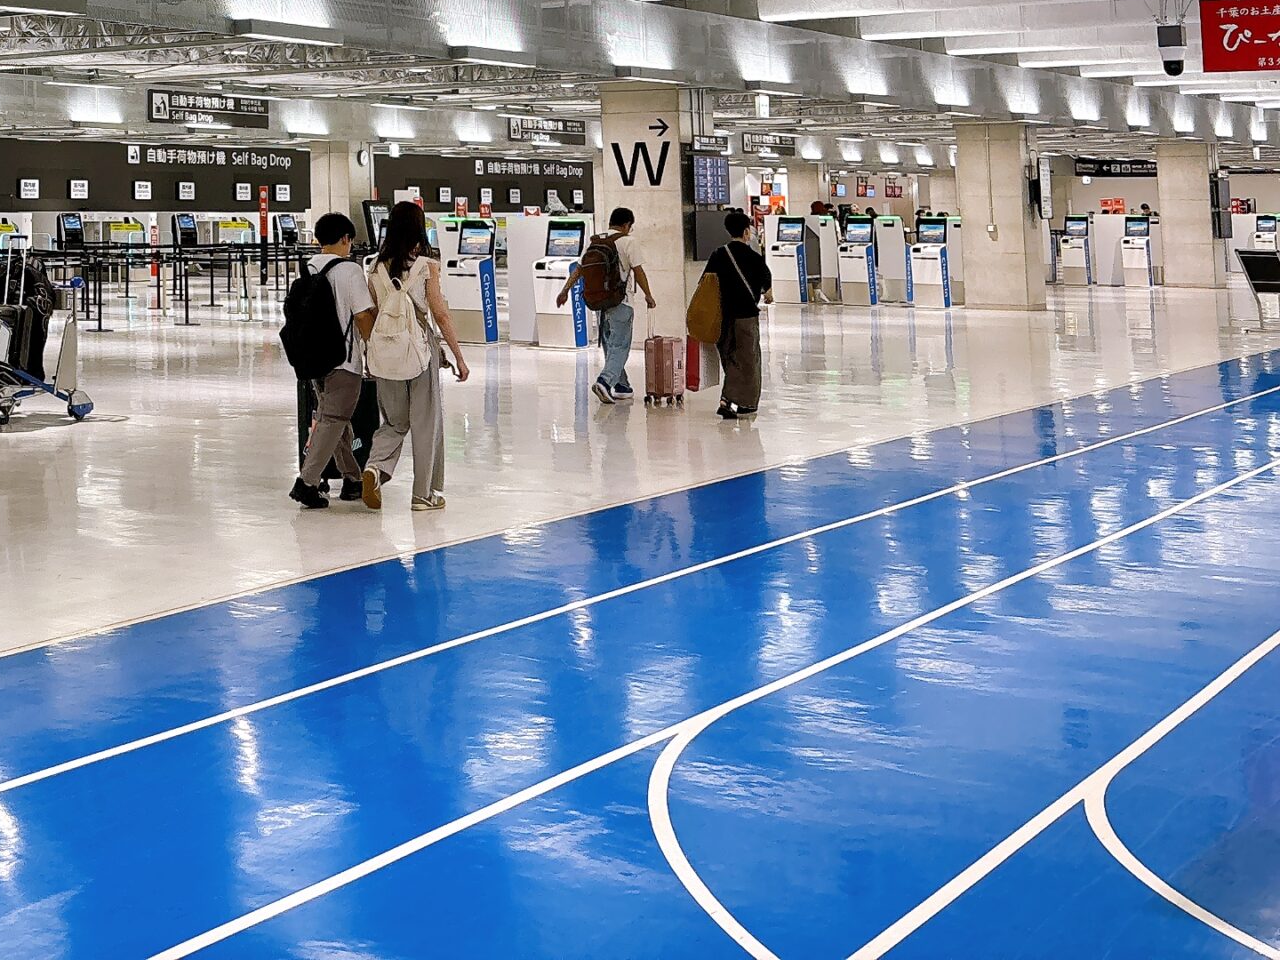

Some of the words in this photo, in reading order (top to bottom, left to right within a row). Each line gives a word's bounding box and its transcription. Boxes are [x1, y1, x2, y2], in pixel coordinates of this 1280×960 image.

[171, 94, 235, 111] 自動手荷物預け機
[171, 110, 184, 121] Self
[185, 112, 197, 123] Bag
[197, 113, 214, 124] Drop
[146, 148, 227, 166] 自動手荷物預け機
[231, 152, 249, 166] Self
[250, 153, 268, 170] Bag
[270, 154, 292, 170] Drop
[611, 141, 671, 186] W
[543, 163, 555, 176] Self
[556, 164, 568, 178] Bag
[568, 165, 583, 178] Drop
[482, 273, 494, 329] Check-in
